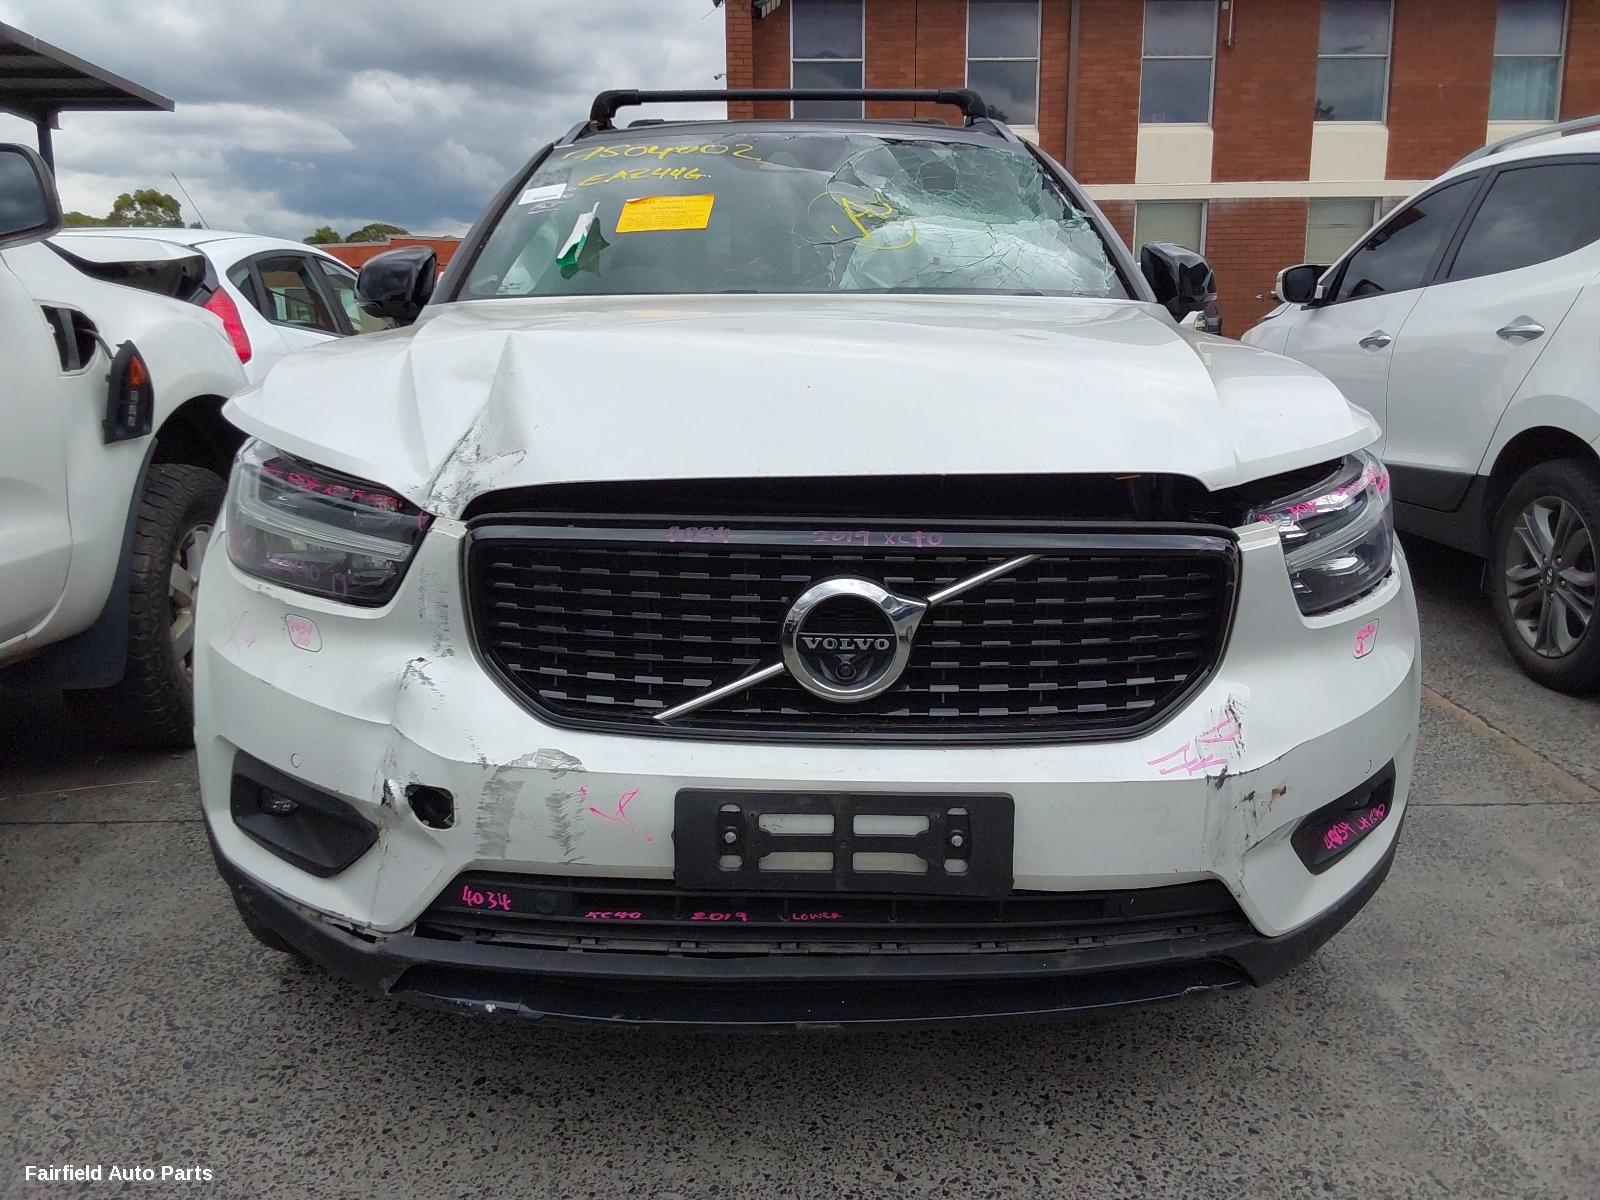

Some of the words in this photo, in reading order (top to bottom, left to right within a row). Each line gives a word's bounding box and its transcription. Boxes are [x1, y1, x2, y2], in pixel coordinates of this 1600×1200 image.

[813, 530, 869, 546] 2019
[802, 637, 890, 651] VOLVO
[461, 885, 512, 911] 4034
[691, 911, 749, 923] 2019
